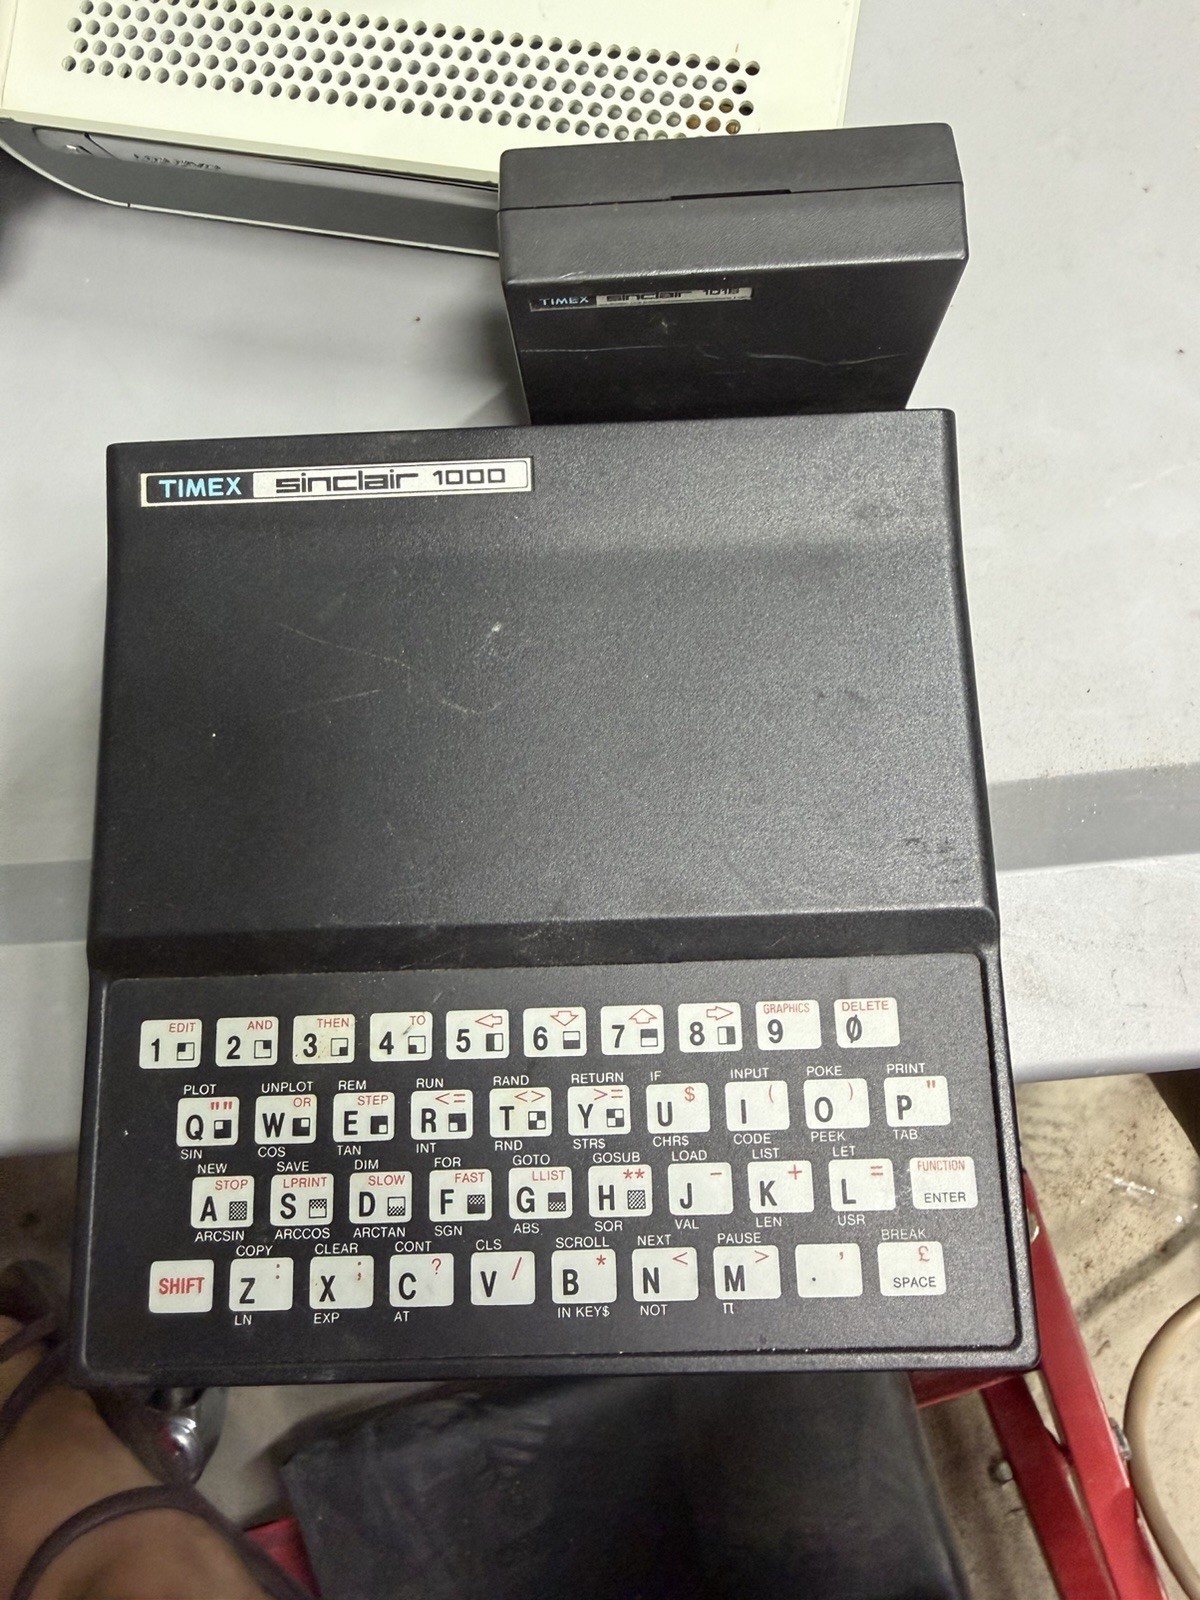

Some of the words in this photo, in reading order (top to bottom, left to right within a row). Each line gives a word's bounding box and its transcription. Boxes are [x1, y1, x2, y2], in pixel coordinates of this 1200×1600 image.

[543, 296, 589, 306] TIMEX
[159, 477, 242, 498] TIMEX
[276, 469, 419, 494] sinclair
[433, 468, 505, 485] 1000
[763, 1003, 810, 1015] GRAPHICS
[842, 1000, 889, 1012] DELETE
[247, 1020, 273, 1030] AND
[316, 1017, 349, 1028] THEN
[409, 1015, 426, 1026] TO
[168, 1022, 196, 1033] EDIT
[768, 1019, 783, 1043] 9
[533, 1026, 548, 1051] 6
[612, 1025, 625, 1048] 7
[690, 1022, 705, 1046] 8
[303, 1033, 317, 1058] 3
[379, 1031, 394, 1055] 4
[456, 1029, 471, 1053] 5
[151, 1038, 160, 1062] 1
[226, 1035, 241, 1060] 2
[730, 1067, 769, 1079] INPUT
[806, 1065, 842, 1077] POKE
[886, 1062, 925, 1074] PRINT
[493, 1075, 529, 1086] RAND
[571, 1072, 624, 1084] RETURN
[650, 1070, 661, 1081] IF
[183, 1084, 216, 1095] PLOT
[261, 1081, 313, 1093] UNPLOT
[338, 1080, 366, 1090] REM
[416, 1078, 443, 1089] RUN
[357, 1094, 389, 1106] STEP
[684, 1086, 695, 1103] $
[293, 1097, 311, 1108] OR
[897, 1095, 912, 1120] P
[657, 1102, 673, 1127] U
[741, 1099, 747, 1124] I
[815, 1097, 833, 1122] O
[421, 1108, 436, 1133] R
[499, 1106, 515, 1131] T
[578, 1104, 593, 1129] Y
[185, 1114, 204, 1141] Q
[262, 1112, 285, 1138] W
[344, 1110, 358, 1136] E
[733, 1133, 771, 1145] CODE
[811, 1131, 846, 1142] PEEK
[893, 1129, 918, 1140] TAB
[337, 1145, 361, 1155] TAN
[416, 1142, 436, 1153] INT
[495, 1140, 523, 1151] RND
[832, 1145, 855, 1157] LET
[181, 1149, 202, 1160] SIN
[258, 1146, 286, 1158] COS
[592, 1151, 640, 1163] GOSUB
[672, 1150, 707, 1161] LOAD
[752, 1147, 780, 1159] LIST
[355, 1159, 379, 1170] DIM
[434, 1157, 461, 1168] FOR
[512, 1154, 550, 1166] GOTO
[917, 1160, 965, 1171] FUNCTION
[198, 1163, 227, 1174] NEW
[277, 1161, 309, 1172] SAVE
[788, 1164, 803, 1180] +
[870, 1165, 884, 1176] =
[368, 1174, 405, 1186] SLOW
[454, 1172, 485, 1183] FAST
[532, 1170, 565, 1181] LLIST
[215, 1179, 248, 1191] STOP
[283, 1176, 327, 1189] LPRINT
[680, 1183, 692, 1209] J
[760, 1181, 777, 1206] K
[841, 1179, 856, 1204] L
[925, 1192, 966, 1202] ENTER
[359, 1191, 375, 1217] D
[440, 1189, 454, 1215] F
[516, 1186, 535, 1213] G
[598, 1185, 615, 1211] H
[200, 1196, 217, 1222] A
[280, 1193, 296, 1220] S
[595, 1220, 623, 1232] SQR
[675, 1219, 699, 1230] VAL
[756, 1216, 782, 1228] LEN
[837, 1214, 865, 1226] USR
[274, 1227, 330, 1240] ARCCOS
[353, 1226, 405, 1238] ARCTAN
[435, 1225, 462, 1237] SGN
[513, 1223, 540, 1234] ABS
[881, 1228, 926, 1241] BREAK
[194, 1230, 244, 1242] ARCSIN
[637, 1234, 671, 1246] NEXT
[717, 1232, 761, 1244] PAUSE
[395, 1241, 432, 1253] CONT
[476, 1239, 502, 1251] CLS
[556, 1236, 609, 1249] SCROLL
[236, 1245, 273, 1257] COPY
[314, 1243, 358, 1255] CLEAR
[918, 1245, 930, 1262] £
[672, 1252, 688, 1265] <
[754, 1250, 769, 1263] >
[431, 1258, 442, 1275] ?
[480, 1271, 497, 1298] V
[563, 1269, 579, 1296] B
[643, 1267, 660, 1294] N
[724, 1265, 745, 1292] M
[893, 1277, 936, 1288] SPACE
[158, 1276, 205, 1295] SHIFT
[239, 1277, 255, 1304] Z
[319, 1275, 336, 1302] X
[398, 1272, 417, 1300] C
[640, 1304, 667, 1316] NOT
[234, 1314, 252, 1326] LN
[314, 1312, 340, 1324] EXP
[394, 1311, 410, 1322] AT
